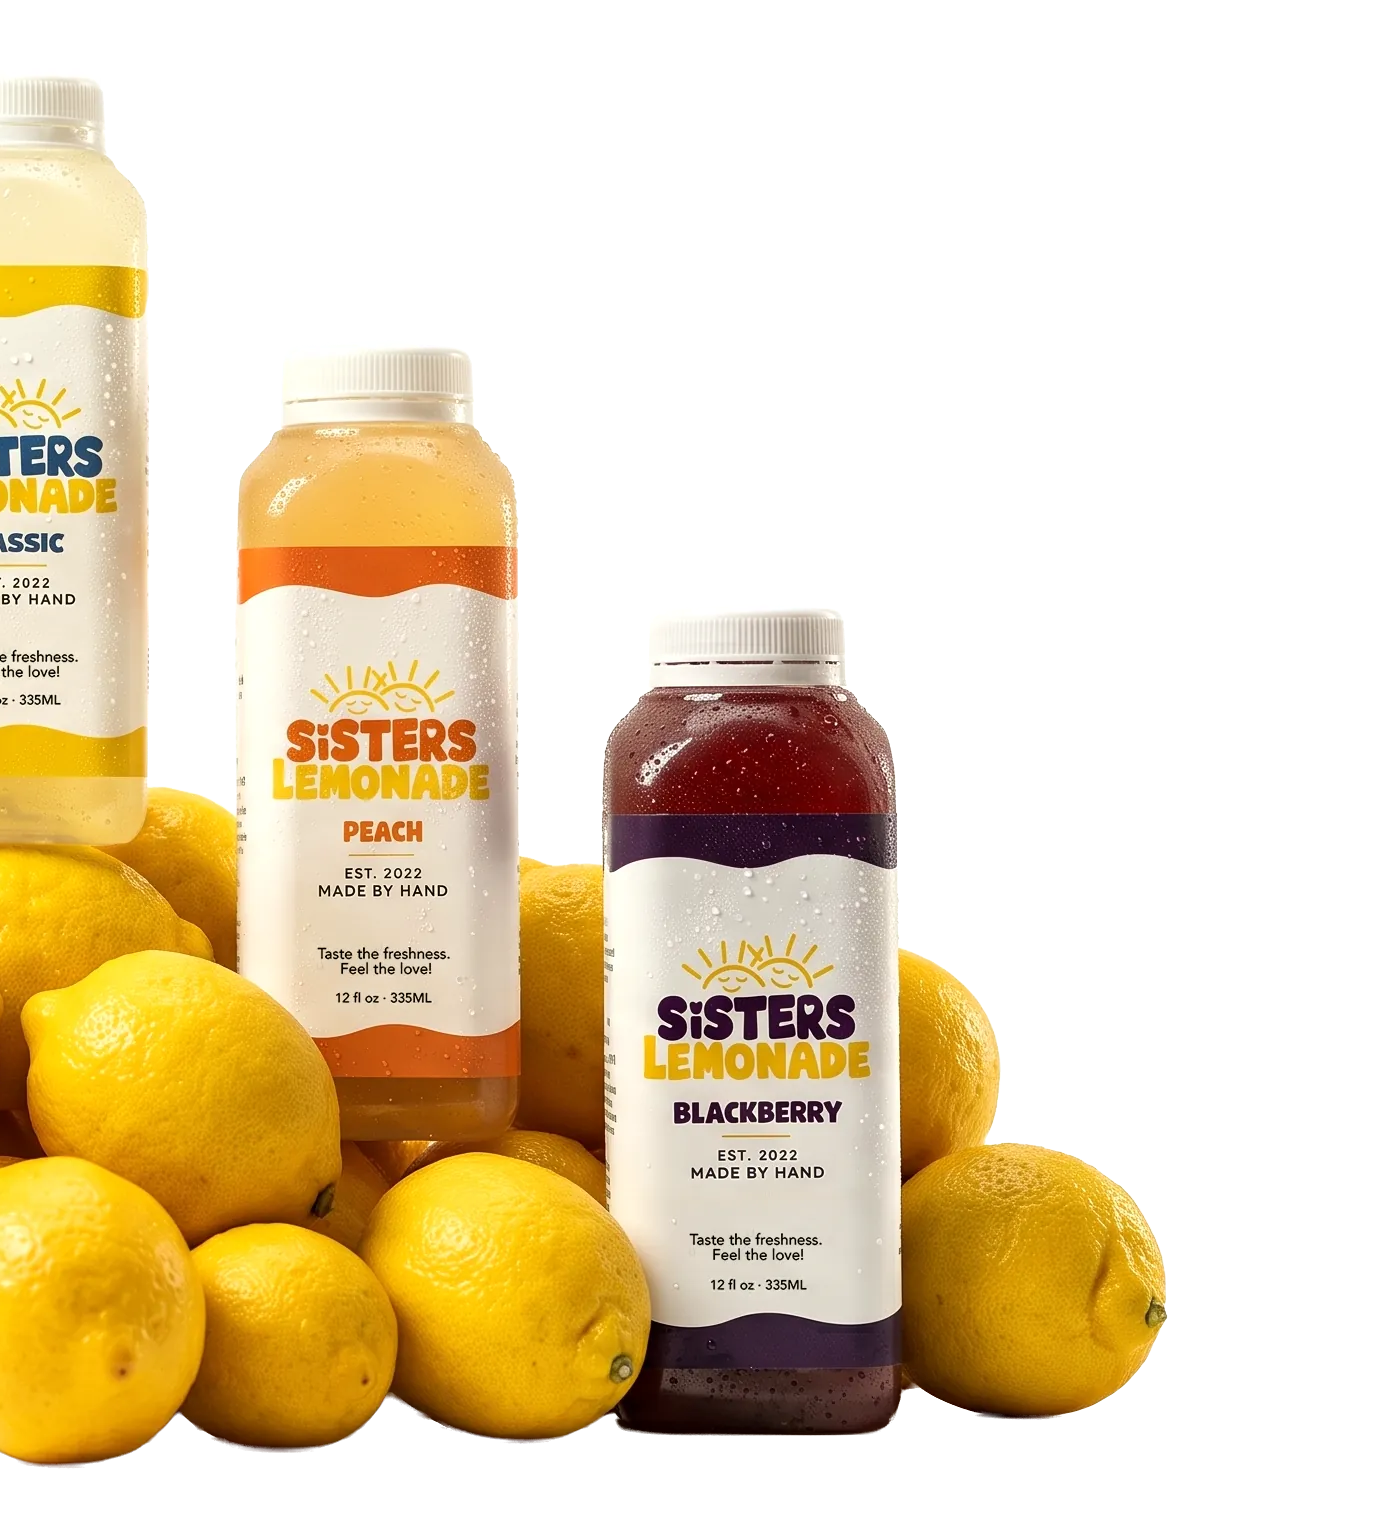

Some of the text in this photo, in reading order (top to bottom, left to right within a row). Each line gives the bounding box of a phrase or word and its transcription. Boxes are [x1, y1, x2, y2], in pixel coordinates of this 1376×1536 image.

[12, 577, 50, 589] 2022
[1, 593, 22, 606] BY
[28, 593, 76, 606] HAND
[10, 649, 79, 663] freshness.
[0, 664, 24, 678] the
[28, 664, 60, 678] love!
[19, 693, 62, 706] 335ML
[272, 758, 489, 801] LEMONADE
[344, 821, 422, 842] PEACH
[344, 867, 422, 880] EST. 2022
[318, 884, 448, 898] MADE BY HAND
[317, 946, 451, 960] Taste the freshness.
[340, 961, 432, 975] Feel the love!
[335, 991, 433, 1004] 12 fl oz 335ML
[644, 1035, 870, 1081] LEMONADE
[674, 1101, 842, 1124] BLACKBERRY
[717, 1149, 798, 1162] EST. 2022
[691, 1166, 825, 1180] MADE BY HAND
[689, 1232, 823, 1246] Taste the freshness.
[712, 1247, 804, 1261] Feel the love!
[710, 1278, 808, 1291] 12 fl oz 335ML
